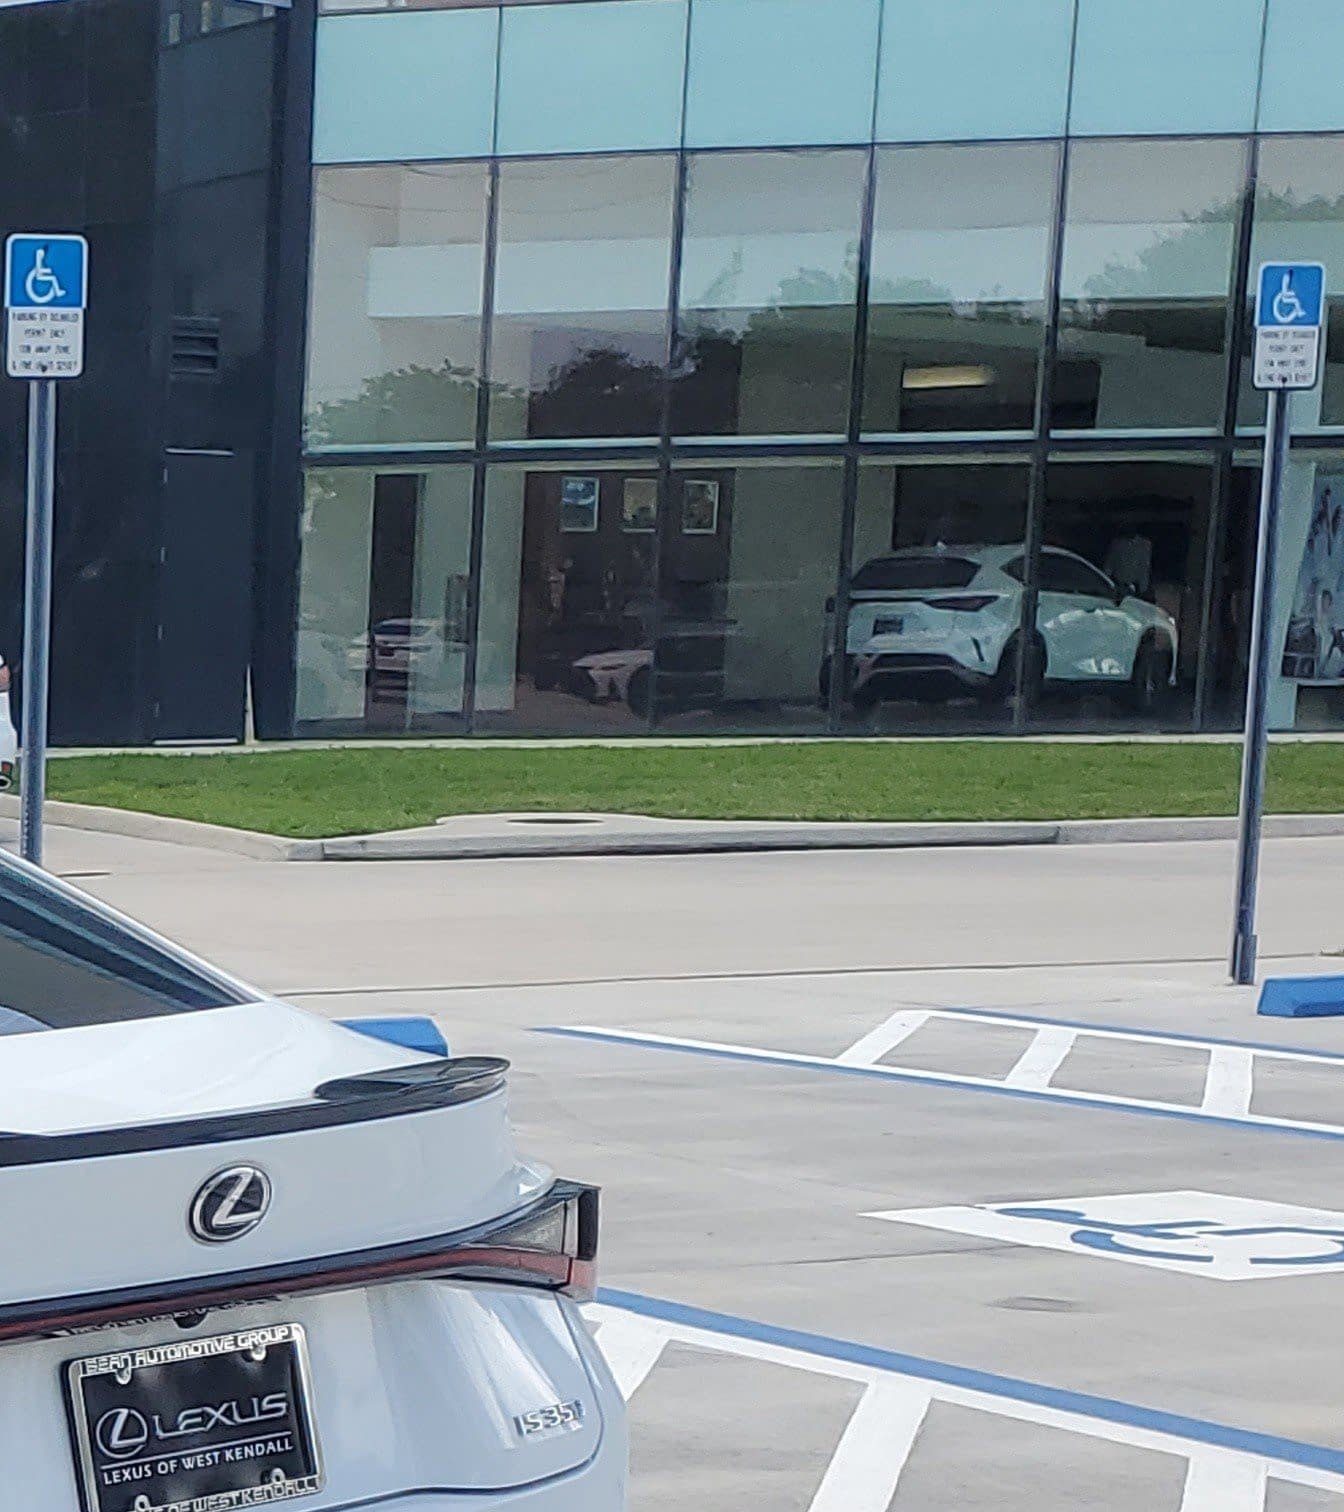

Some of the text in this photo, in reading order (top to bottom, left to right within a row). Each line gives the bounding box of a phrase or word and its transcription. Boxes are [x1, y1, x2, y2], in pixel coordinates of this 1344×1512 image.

[135, 1336, 235, 1367] AUTOMOTIVE
[237, 1326, 289, 1347] GROUP
[153, 1392, 287, 1440] LEXUS
[102, 1438, 293, 1485] LEXUS OF WEST KENDALL
[192, 1493, 240, 1512] WEST
[241, 1478, 317, 1503] KENDALL
